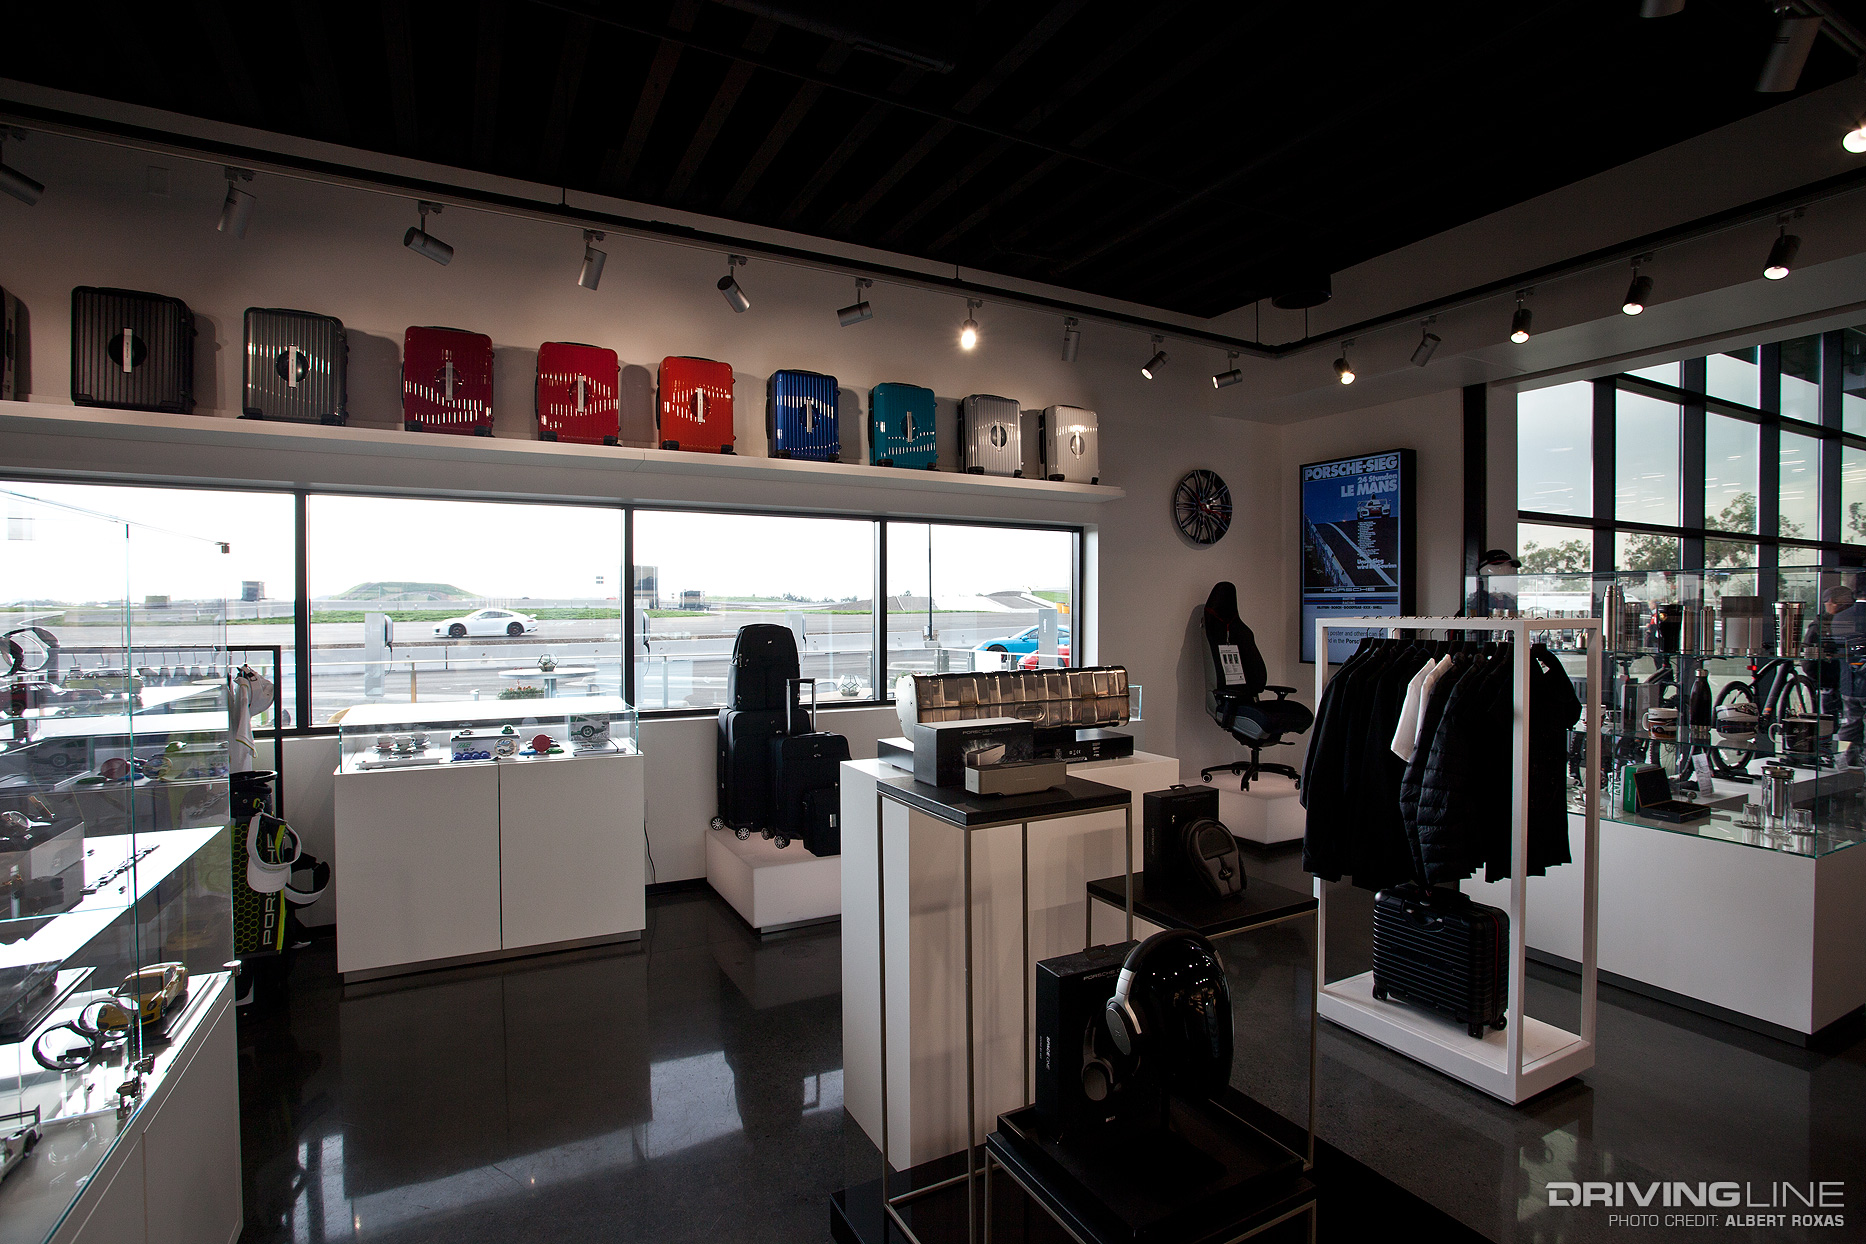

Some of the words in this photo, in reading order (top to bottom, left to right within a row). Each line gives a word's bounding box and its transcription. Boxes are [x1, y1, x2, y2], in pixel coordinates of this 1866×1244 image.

[1304, 455, 1398, 481] PORSCHE-SIEG
[1357, 476, 1368, 484] 24
[1368, 472, 1398, 482] Stunden
[1340, 484, 1355, 498] LE
[1356, 478, 1398, 496] MANS
[1330, 630, 1344, 638] poster
[262, 832, 276, 946] PORHE
[1083, 969, 1116, 981] PORSCHE
